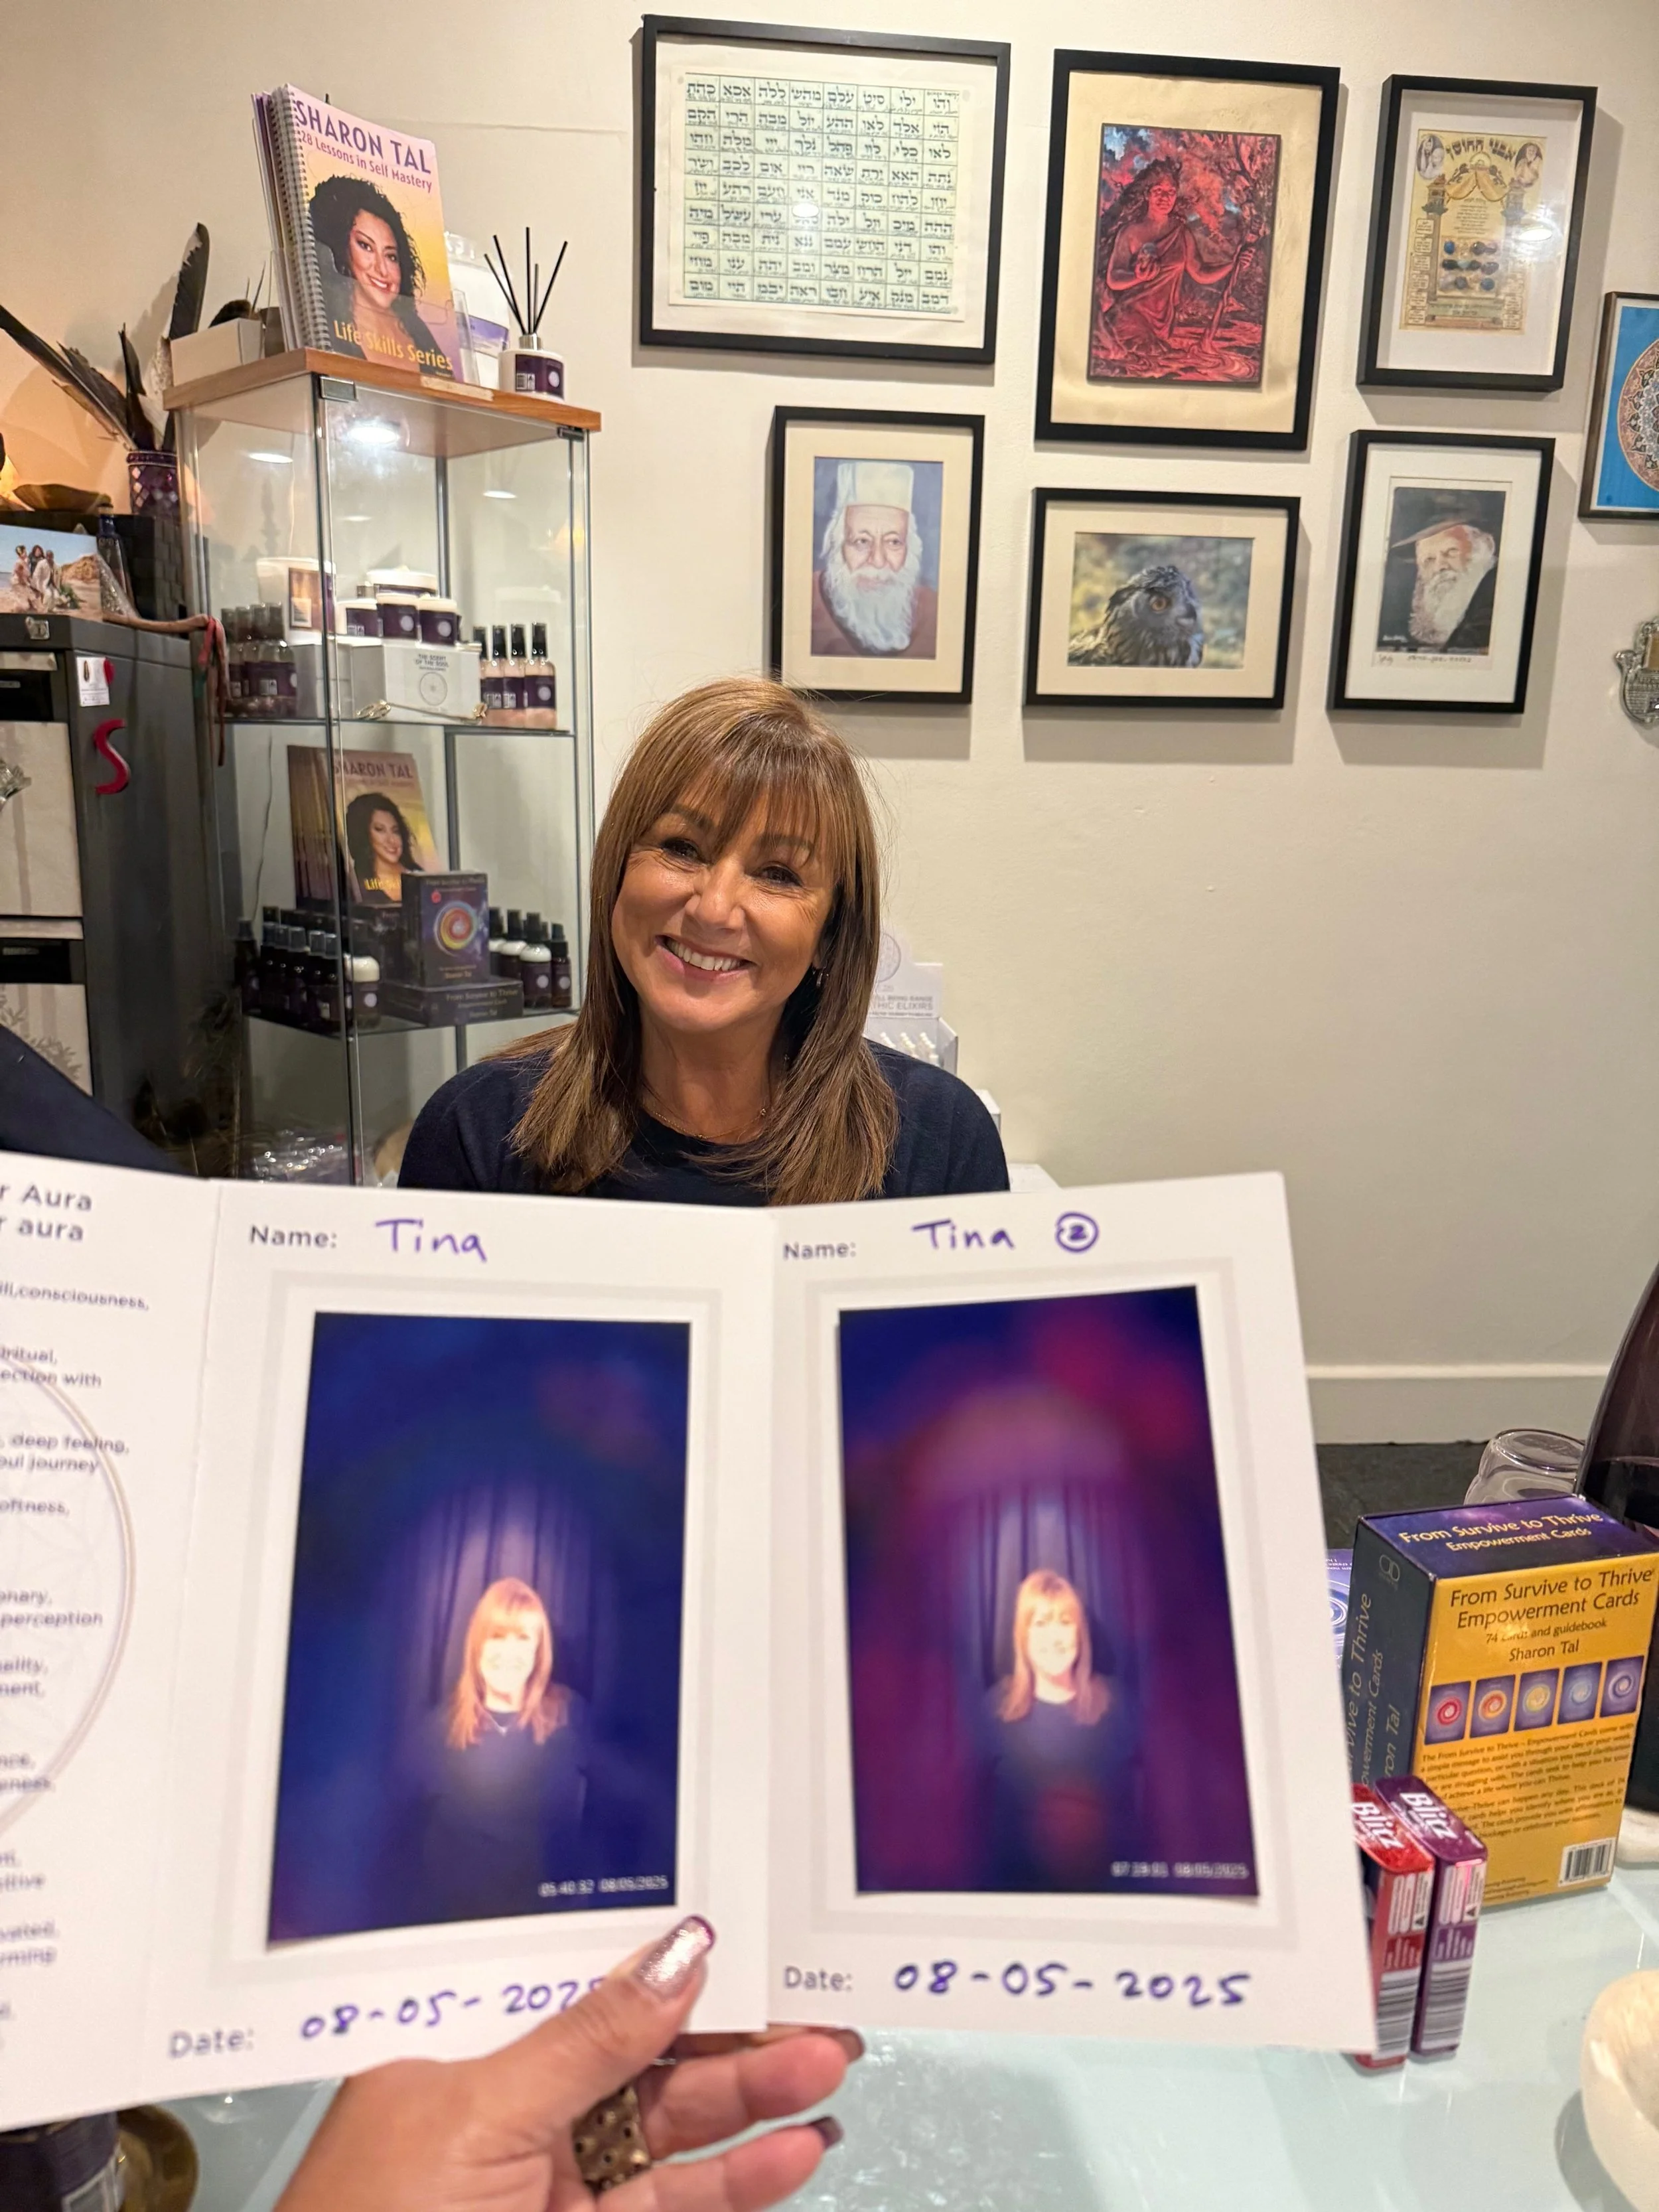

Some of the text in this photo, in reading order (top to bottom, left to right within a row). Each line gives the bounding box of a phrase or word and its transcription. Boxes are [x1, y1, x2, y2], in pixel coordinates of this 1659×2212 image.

[723, 86, 751, 96] אכא
[759, 82, 786, 98] ללה
[296, 100, 431, 174] SHARON TAL
[302, 131, 432, 193] 28 Lessons in Self Mastery
[334, 320, 453, 370] Life Skills Series
[22, 1184, 92, 1212] Aura
[19, 1218, 84, 1242] aura
[250, 1225, 336, 1248] Name:
[375, 1218, 486, 1263] Tina
[911, 1218, 1015, 1251] Tina
[783, 1242, 857, 1260] Name:
[64, 1372, 102, 1388] with
[11, 1434, 58, 1449] deep
[29, 1456, 100, 1475] journey
[1399, 1512, 1604, 1544] From Survive to Thrive
[1445, 1527, 1592, 1552] Empowerment Cards
[1451, 1569, 1653, 1607] From Survive to Thrive
[1, 1612, 103, 1627] perception
[1457, 1589, 1640, 1629] Empowerment Cards
[1351, 1593, 1372, 1662] Thrive
[1486, 1633, 1498, 1643] 74
[1531, 1627, 1551, 1639] and
[1553, 1618, 1607, 1639] guidebook
[1508, 1639, 1580, 1661] Sharon Tal
[1348, 1672, 1362, 1697] to
[1369, 1649, 1384, 1698] Cards
[1386, 1704, 1401, 1735] Tal
[1438, 1750, 1457, 1759] From
[1497, 1740, 1518, 1750] Thrive
[1352, 1802, 1405, 1849] Blitz
[1400, 1793, 1459, 1839] Blitz
[784, 1966, 853, 1992] Date:
[169, 2028, 255, 2057] Date:
